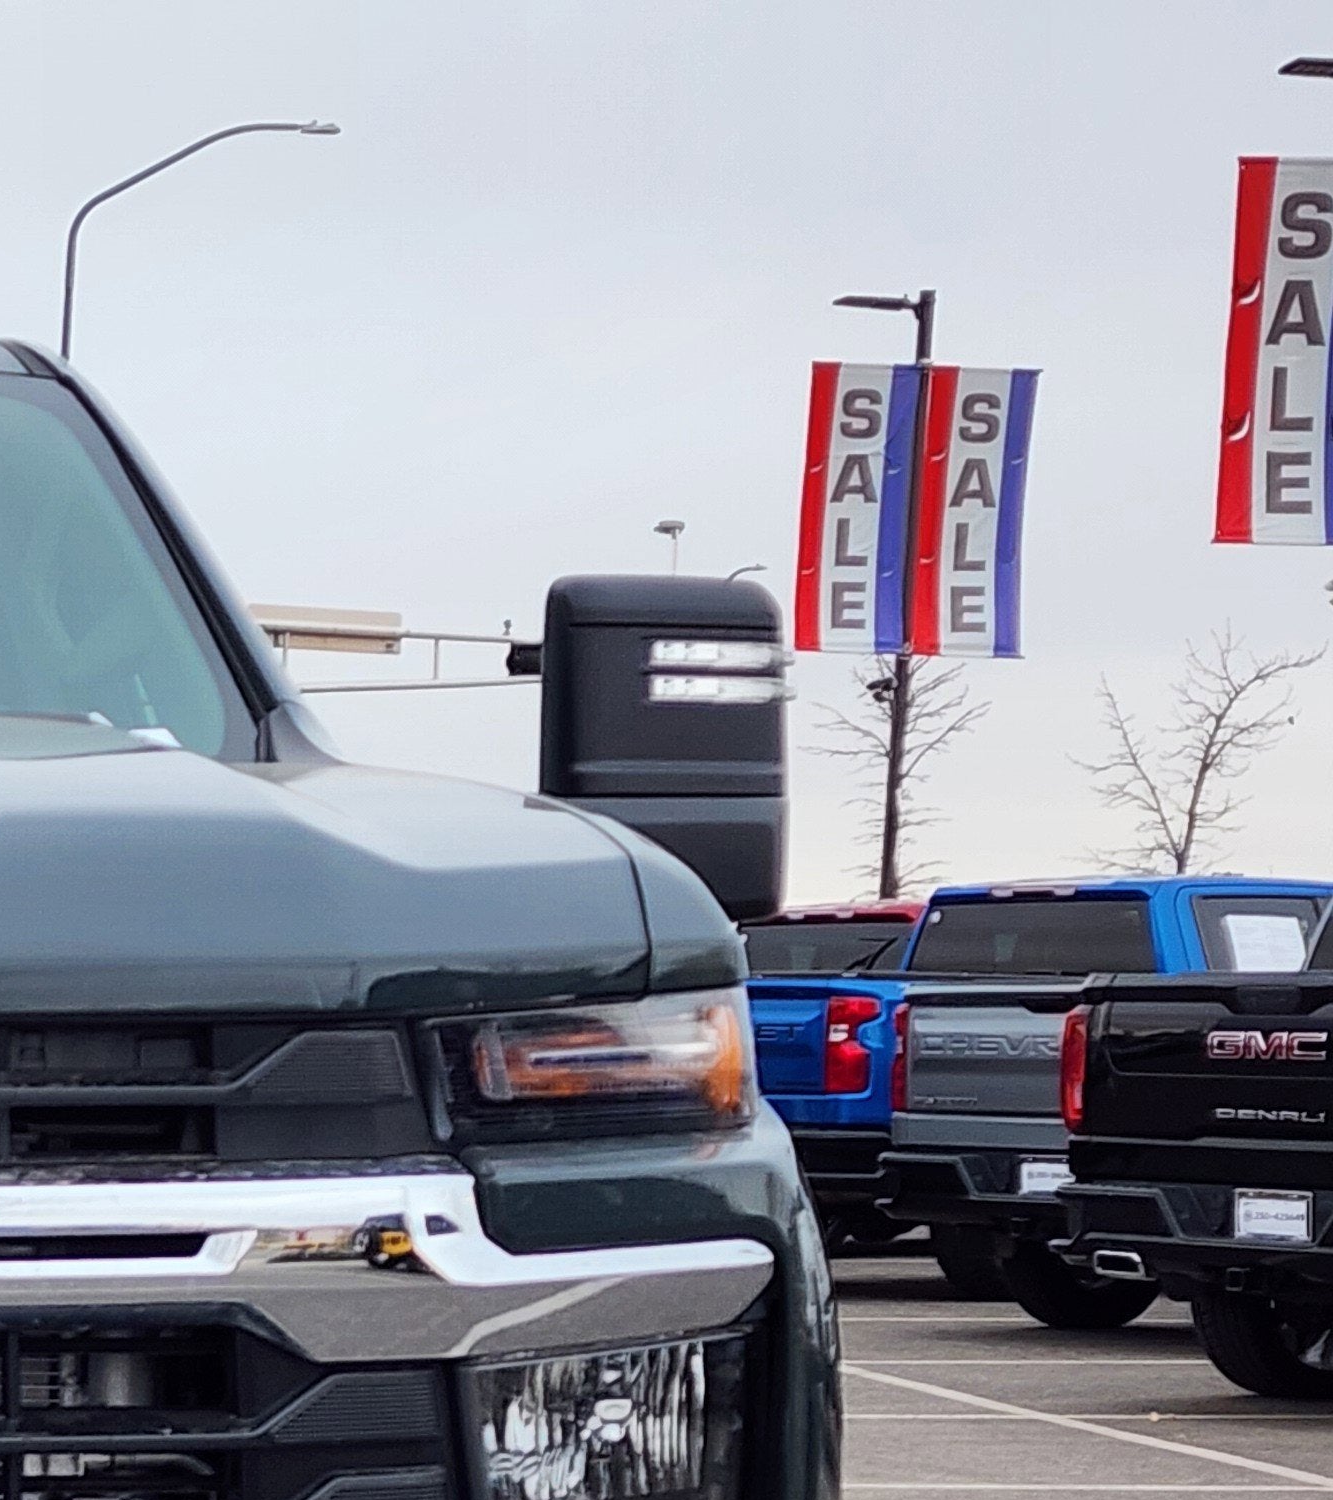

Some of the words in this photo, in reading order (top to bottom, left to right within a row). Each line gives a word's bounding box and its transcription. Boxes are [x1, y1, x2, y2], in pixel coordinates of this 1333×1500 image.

[1264, 191, 1333, 516] SALE
[829, 388, 883, 630] SALE
[948, 393, 1002, 633] SALE
[1206, 1030, 1329, 1061] GMC
[1214, 1107, 1326, 1123] DENALI
